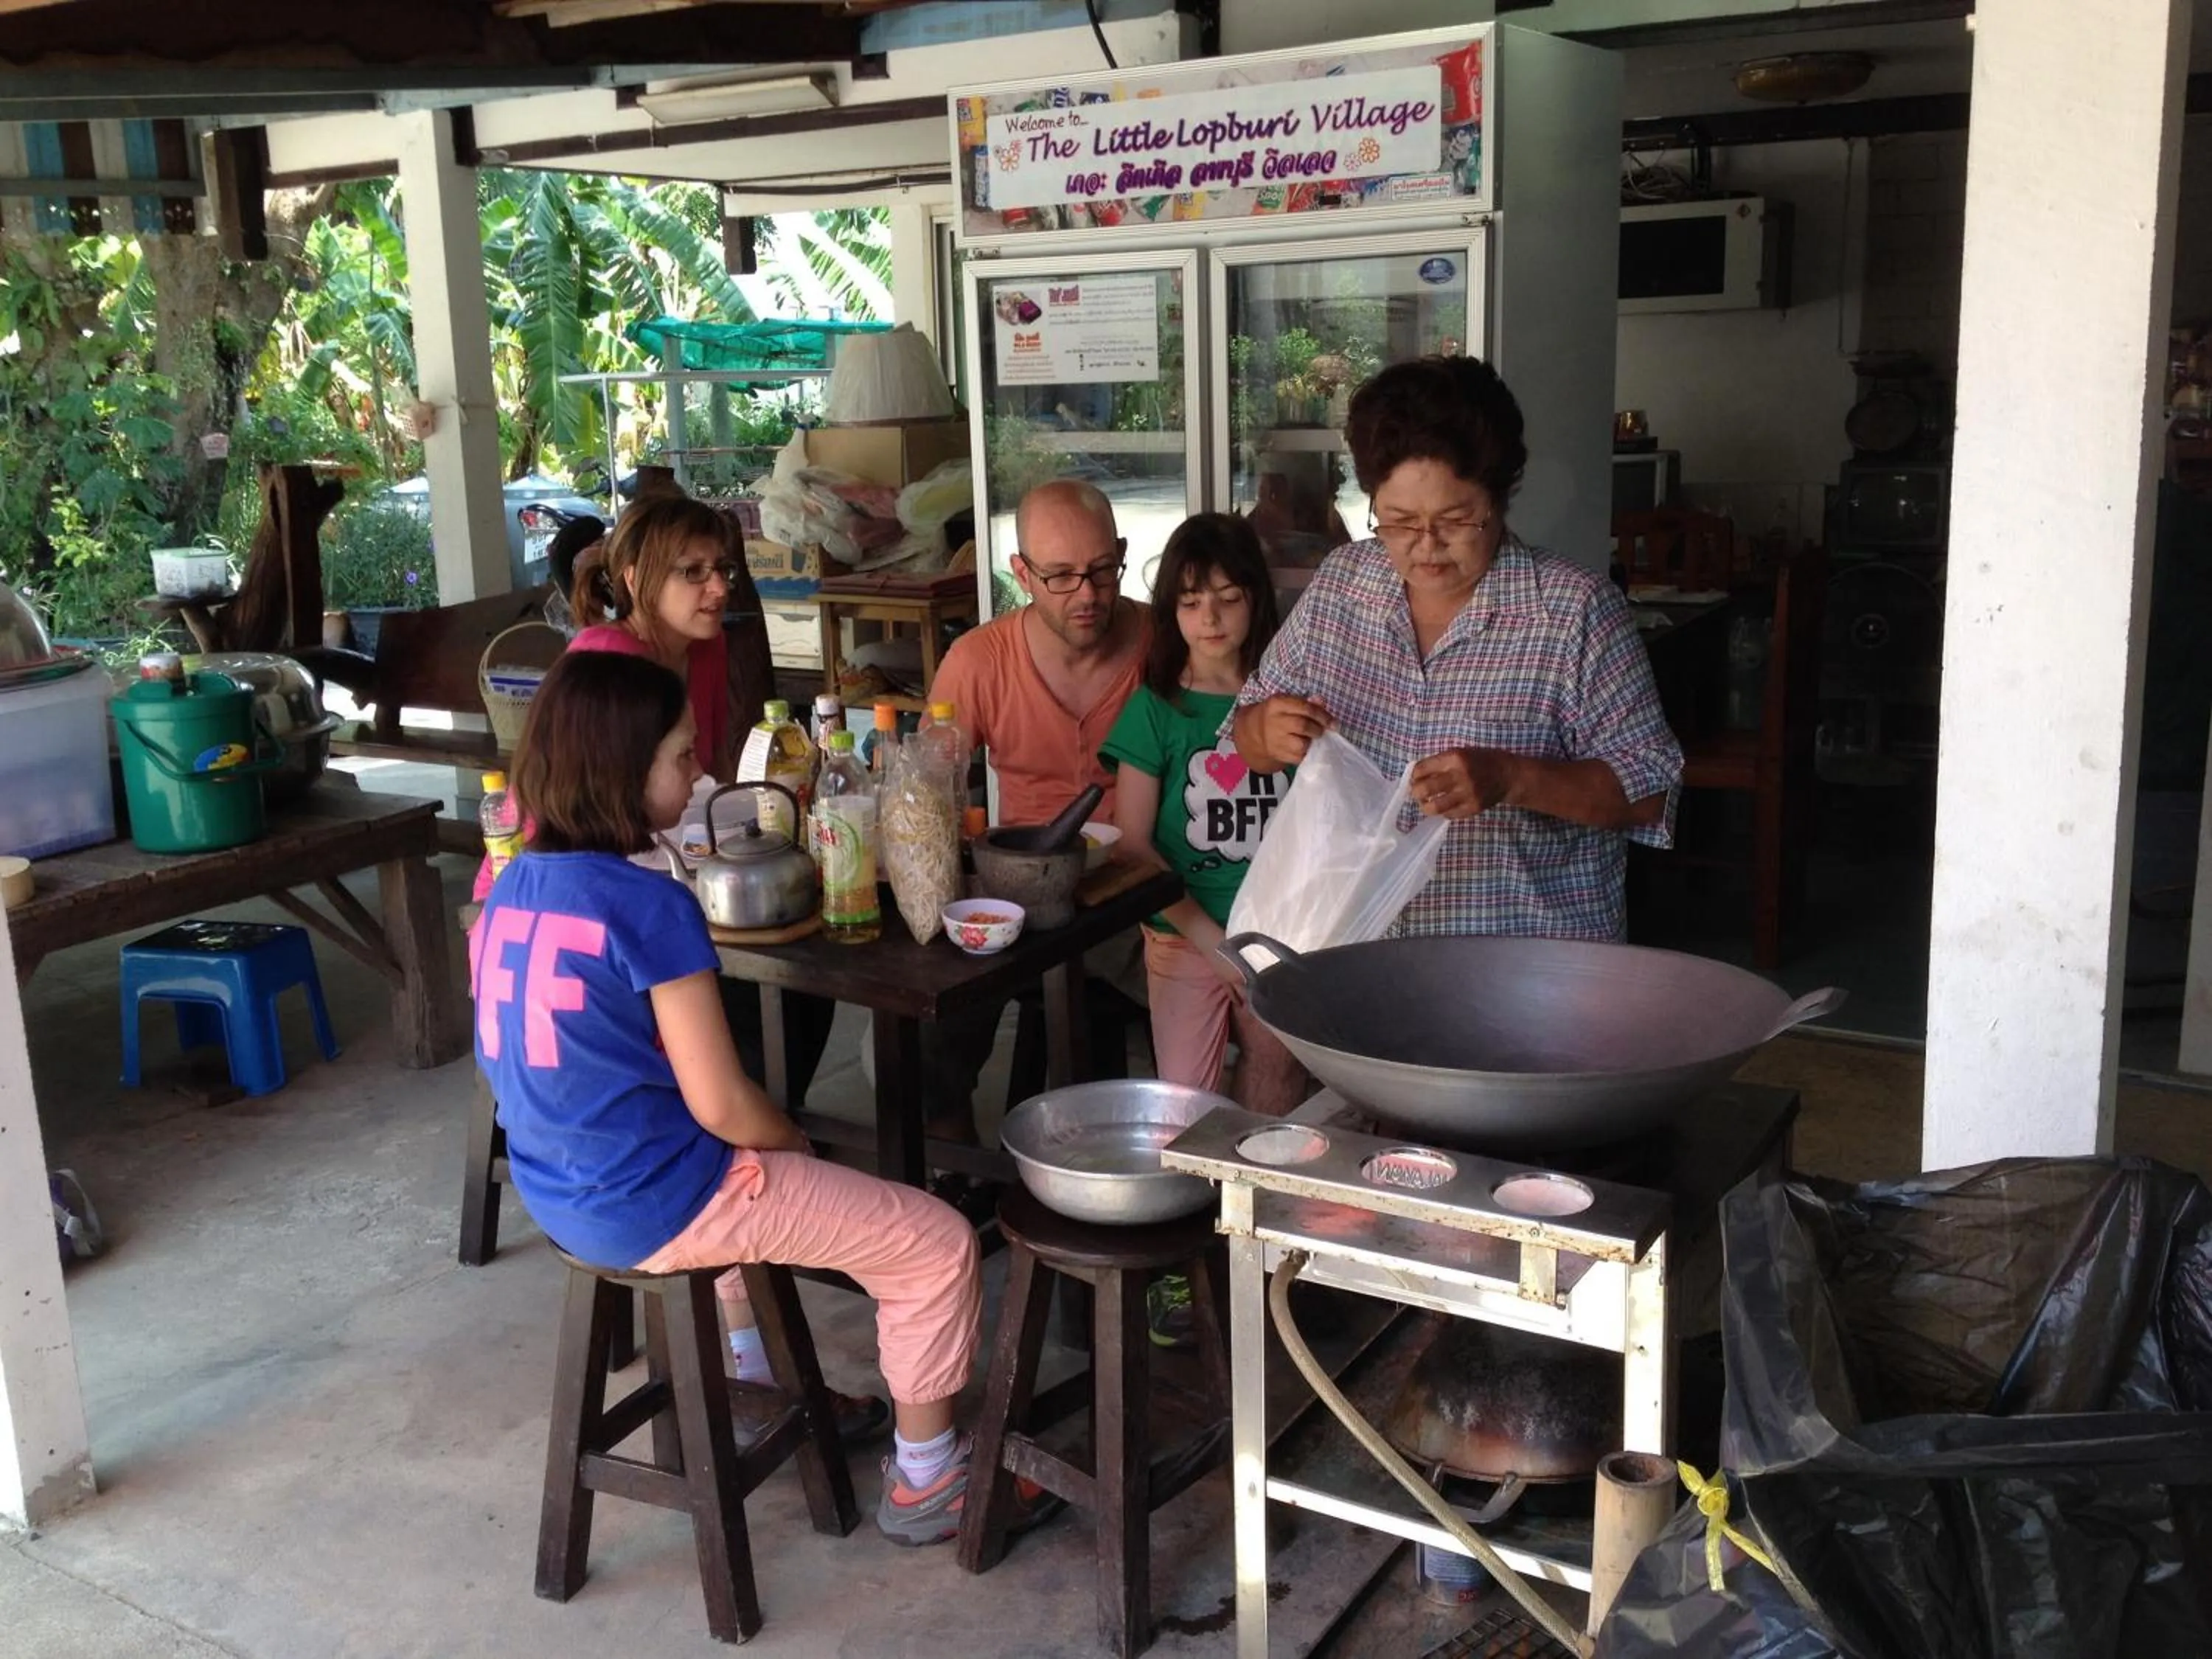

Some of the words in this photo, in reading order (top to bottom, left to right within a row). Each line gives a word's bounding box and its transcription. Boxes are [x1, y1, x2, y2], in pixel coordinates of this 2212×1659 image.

[1005, 114, 1065, 133] Welcome
[1026, 131, 1081, 161] The
[1093, 119, 1175, 156] Little
[1177, 107, 1301, 153] Lopburi
[1310, 96, 1436, 135] Village
[467, 906, 607, 1069] FF
